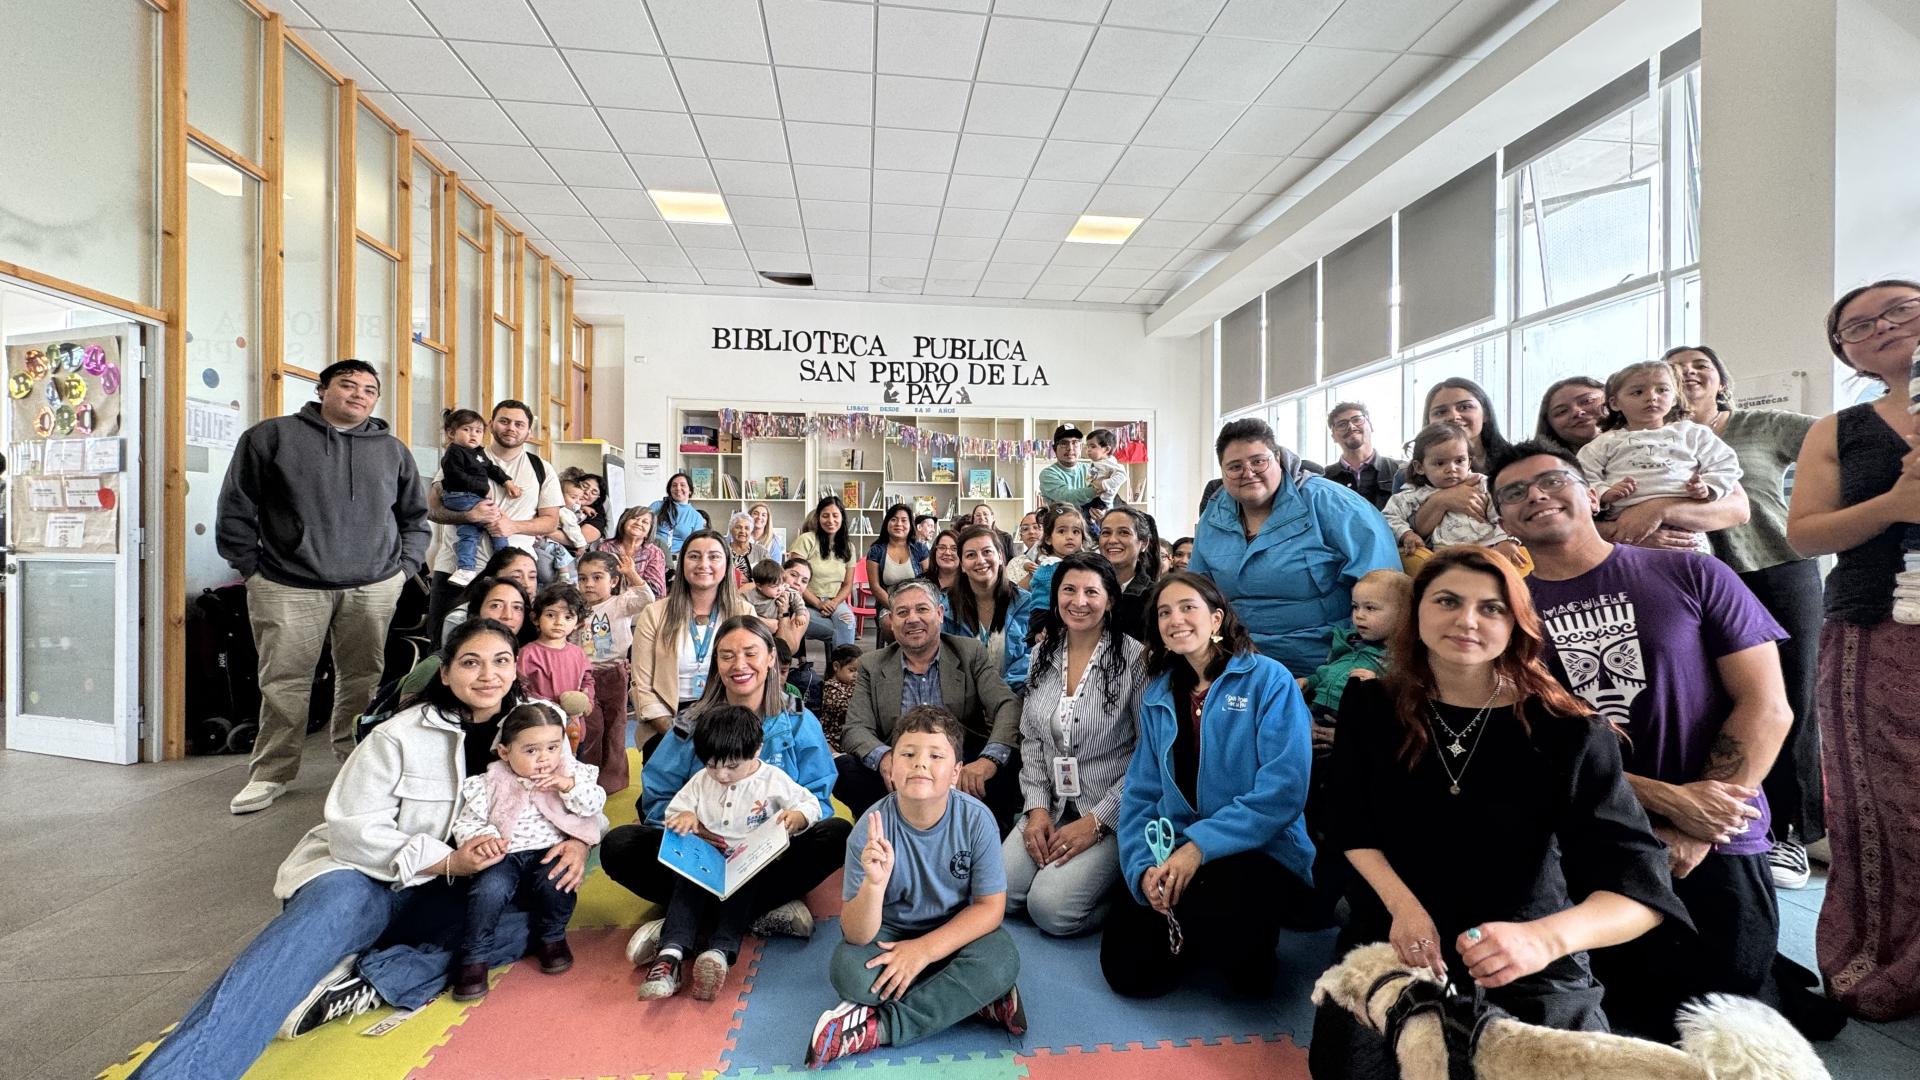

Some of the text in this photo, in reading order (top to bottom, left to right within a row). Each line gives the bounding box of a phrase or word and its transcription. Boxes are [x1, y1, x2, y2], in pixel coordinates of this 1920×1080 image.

[712, 327, 1027, 361] BIBLIOTECA PUBLICA
[800, 359, 1050, 386] SAN PEDRO DE LA
[906, 383, 952, 404] PAZ
[1543, 592, 1631, 618] MACULELE
